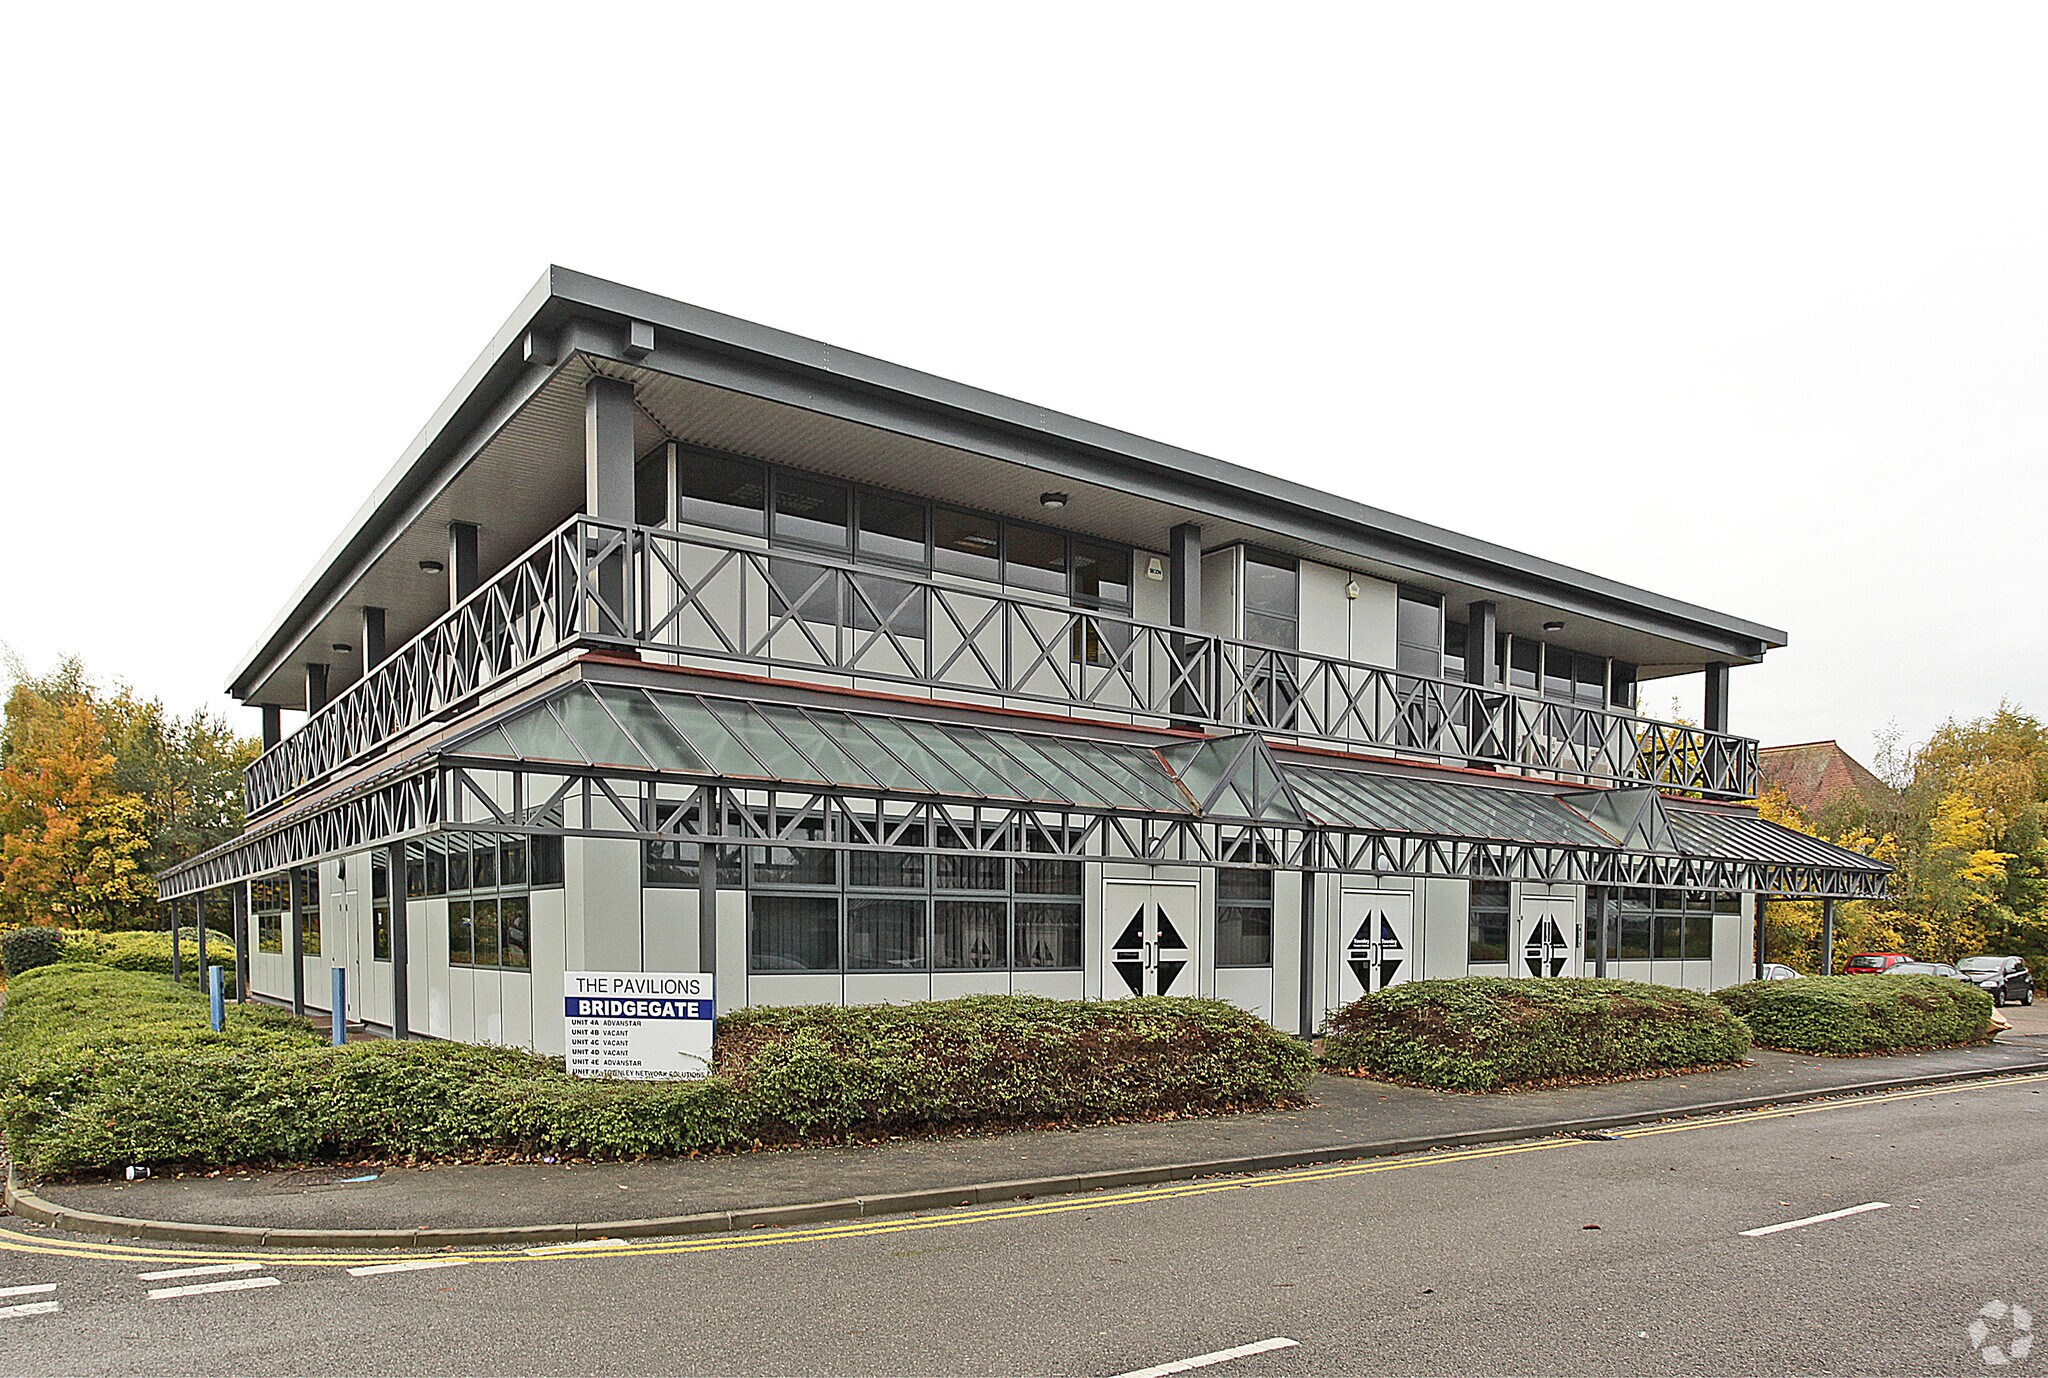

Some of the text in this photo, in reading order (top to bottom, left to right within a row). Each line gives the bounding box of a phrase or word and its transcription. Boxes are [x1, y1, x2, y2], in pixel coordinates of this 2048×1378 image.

[576, 978, 700, 995] THE PAVILIONS
[578, 1000, 699, 1018] BRIDGEGATE
